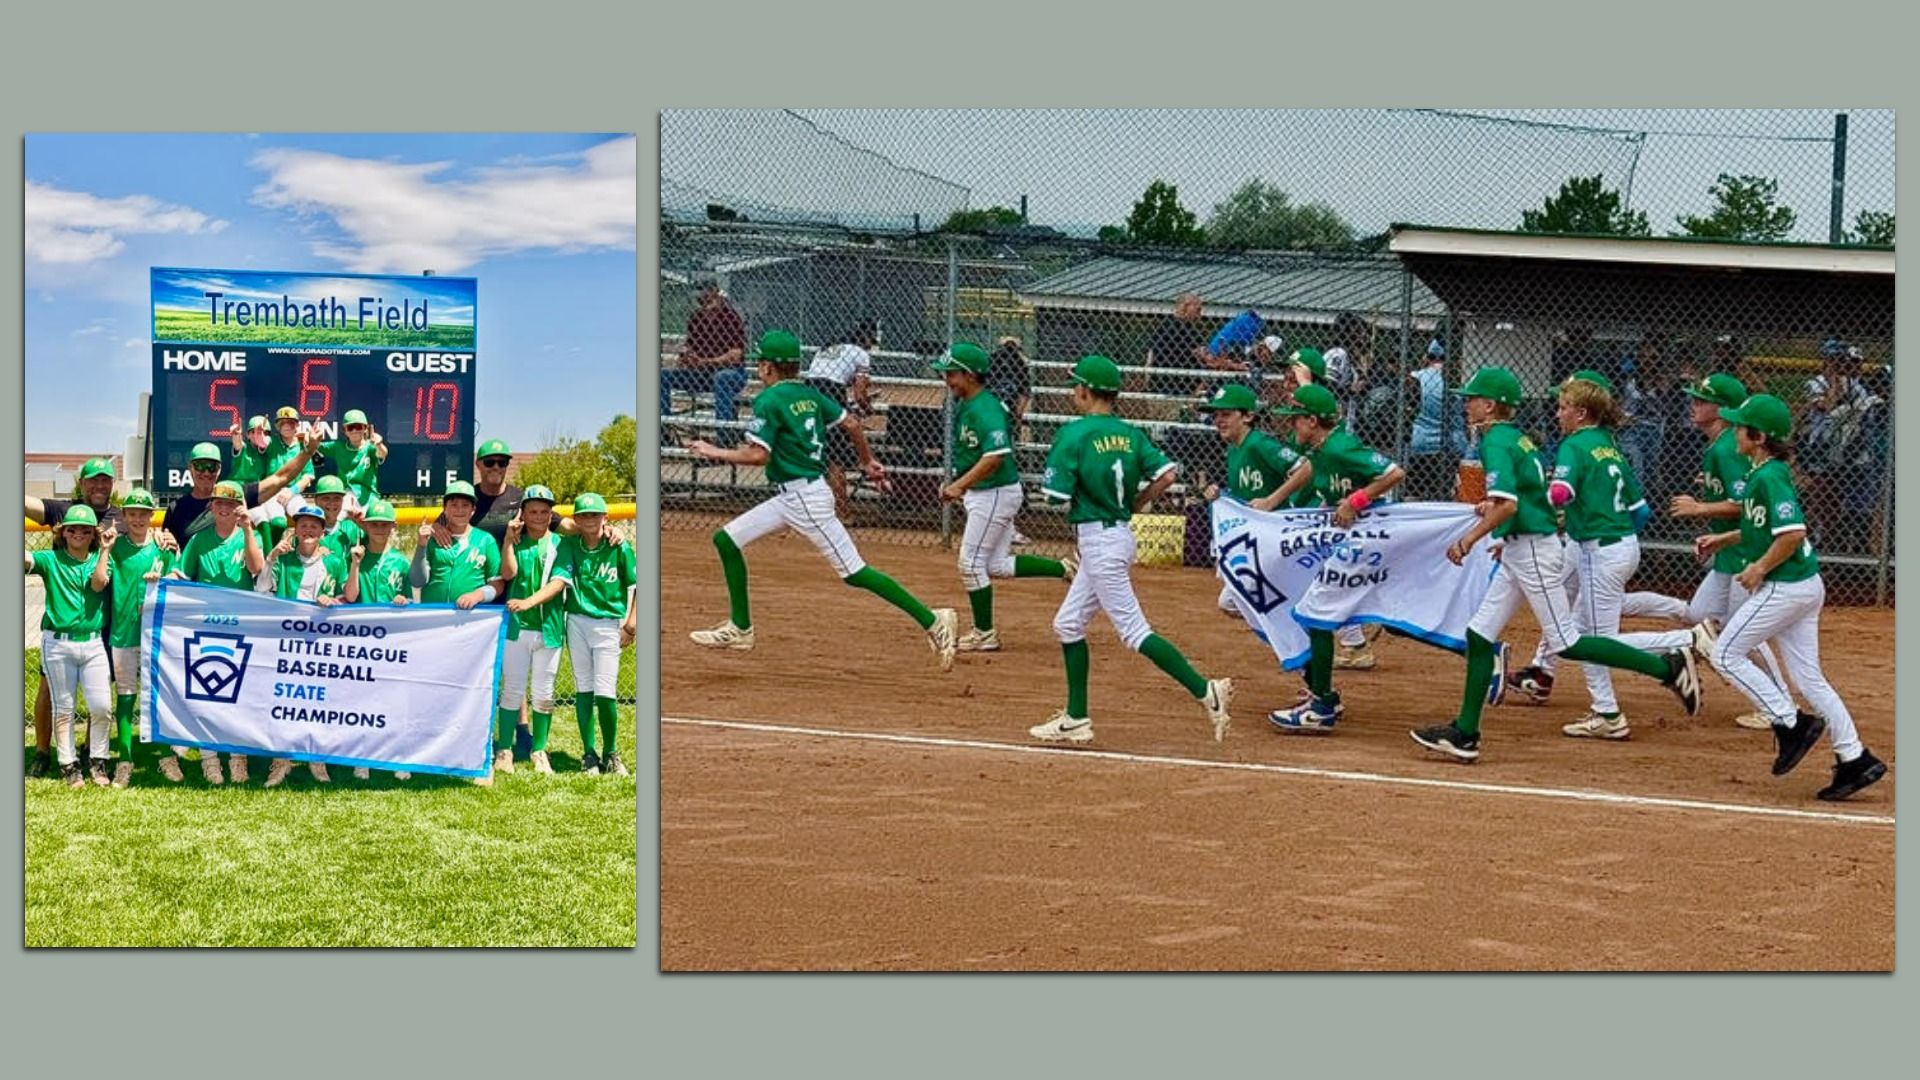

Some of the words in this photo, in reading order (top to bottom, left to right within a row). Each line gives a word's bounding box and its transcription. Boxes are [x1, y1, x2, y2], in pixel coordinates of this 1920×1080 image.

[205, 292, 346, 329] Trembath
[358, 297, 428, 331] Field
[163, 350, 247, 371] HOME
[267, 347, 371, 356] WWW.COLORADOTIME.COM
[386, 353, 473, 373] GUEST
[300, 358, 332, 416] 6
[208, 379, 240, 437] 5
[413, 382, 459, 440] 10
[416, 469, 431, 488] H
[1239, 466, 1264, 491] NB
[1607, 464, 1626, 513] 2
[597, 562, 618, 583] NB
[202, 613, 240, 626] 2025
[281, 619, 388, 640] COLORADO
[279, 639, 332, 658] LITTLE
[337, 644, 408, 664] LEAGUE
[276, 658, 376, 683] BASEBALL
[273, 682, 326, 702] STATE
[271, 706, 387, 729] CHAMPIONS
